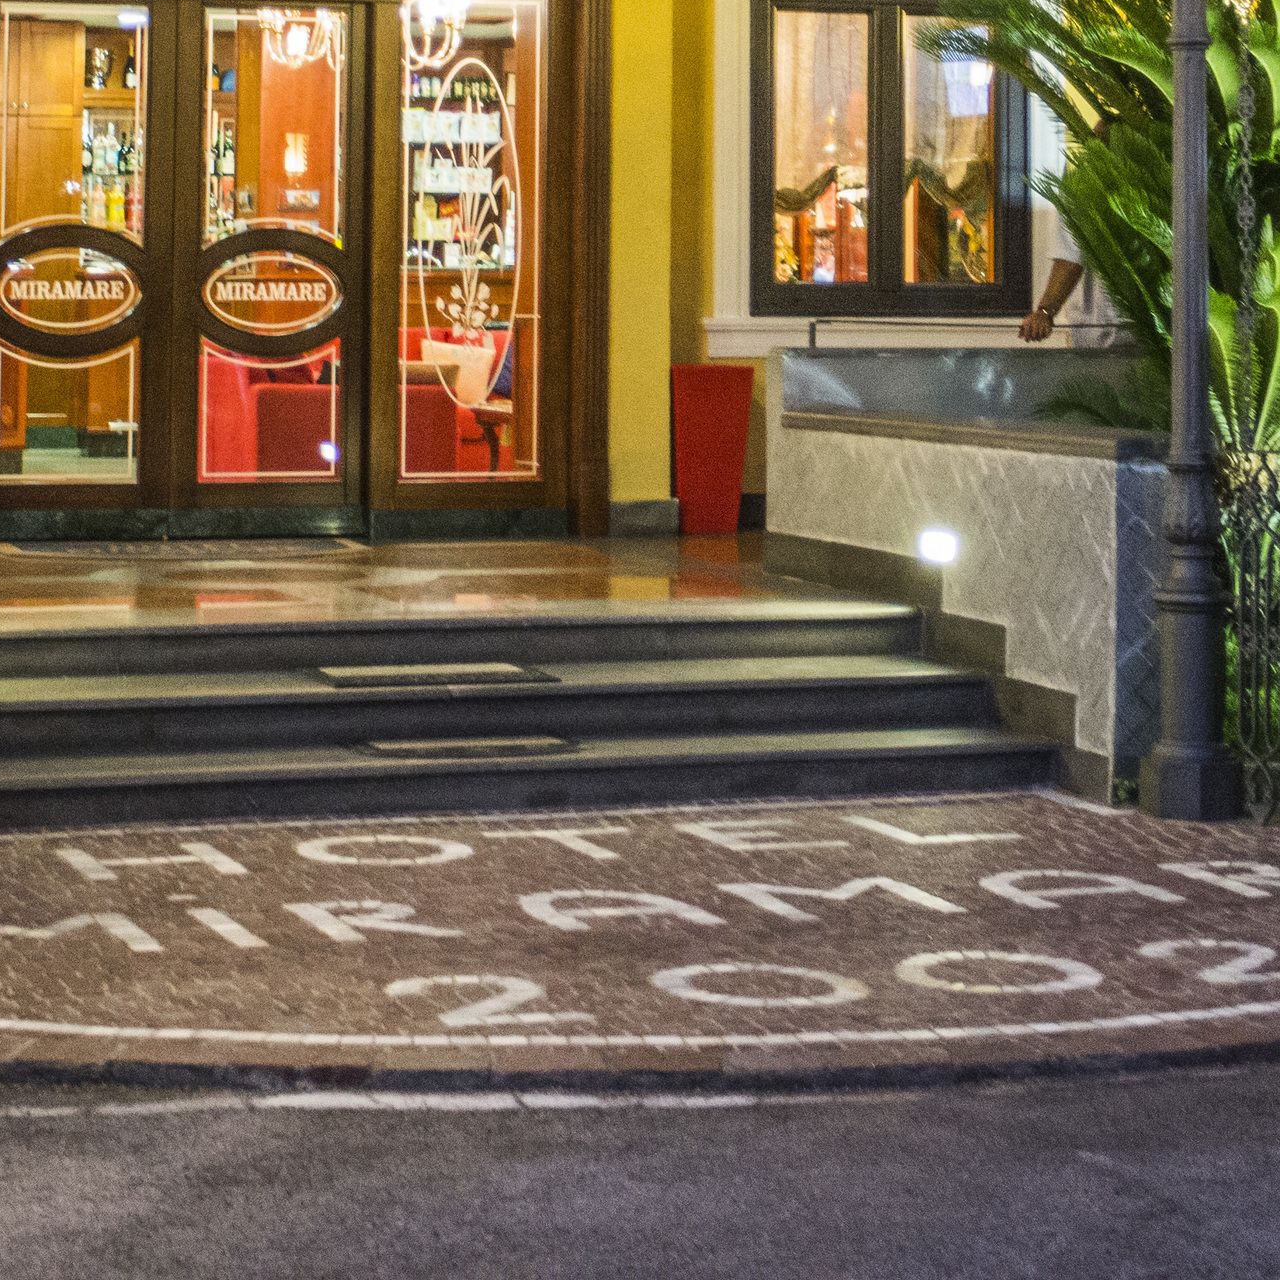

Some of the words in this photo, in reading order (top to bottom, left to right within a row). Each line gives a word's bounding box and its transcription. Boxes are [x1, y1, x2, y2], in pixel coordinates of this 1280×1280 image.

[10, 280, 125, 301] MIRAMARE
[215, 282, 327, 303] MIRAMARE
[56, 814, 1022, 881] HOTEL
